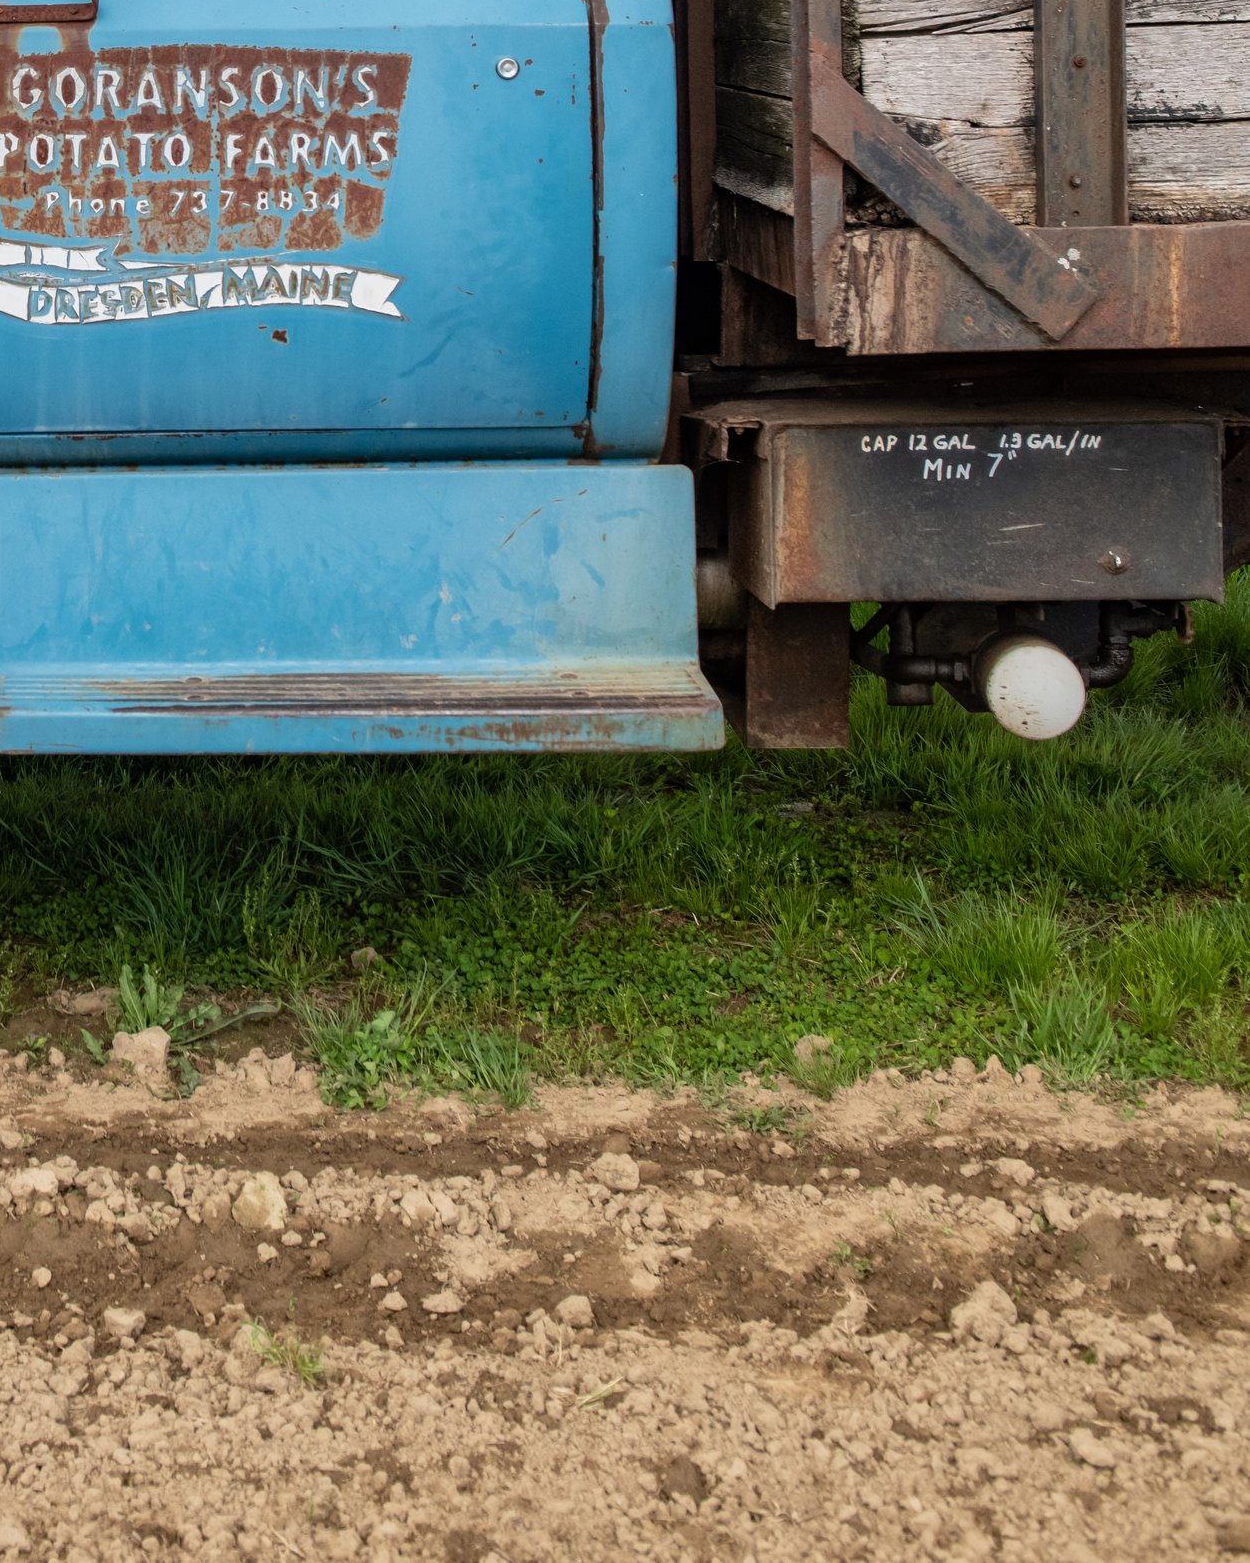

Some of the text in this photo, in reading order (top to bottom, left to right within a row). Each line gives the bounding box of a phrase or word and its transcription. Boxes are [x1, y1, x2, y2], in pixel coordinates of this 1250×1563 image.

[12, 63, 379, 110] GORANSON'S
[224, 131, 392, 169] FARMS
[45, 191, 151, 215] Phone
[222, 268, 358, 304] MAINE
[861, 429, 1102, 456] CAP 12 GAL 1.3 GAL/IN
